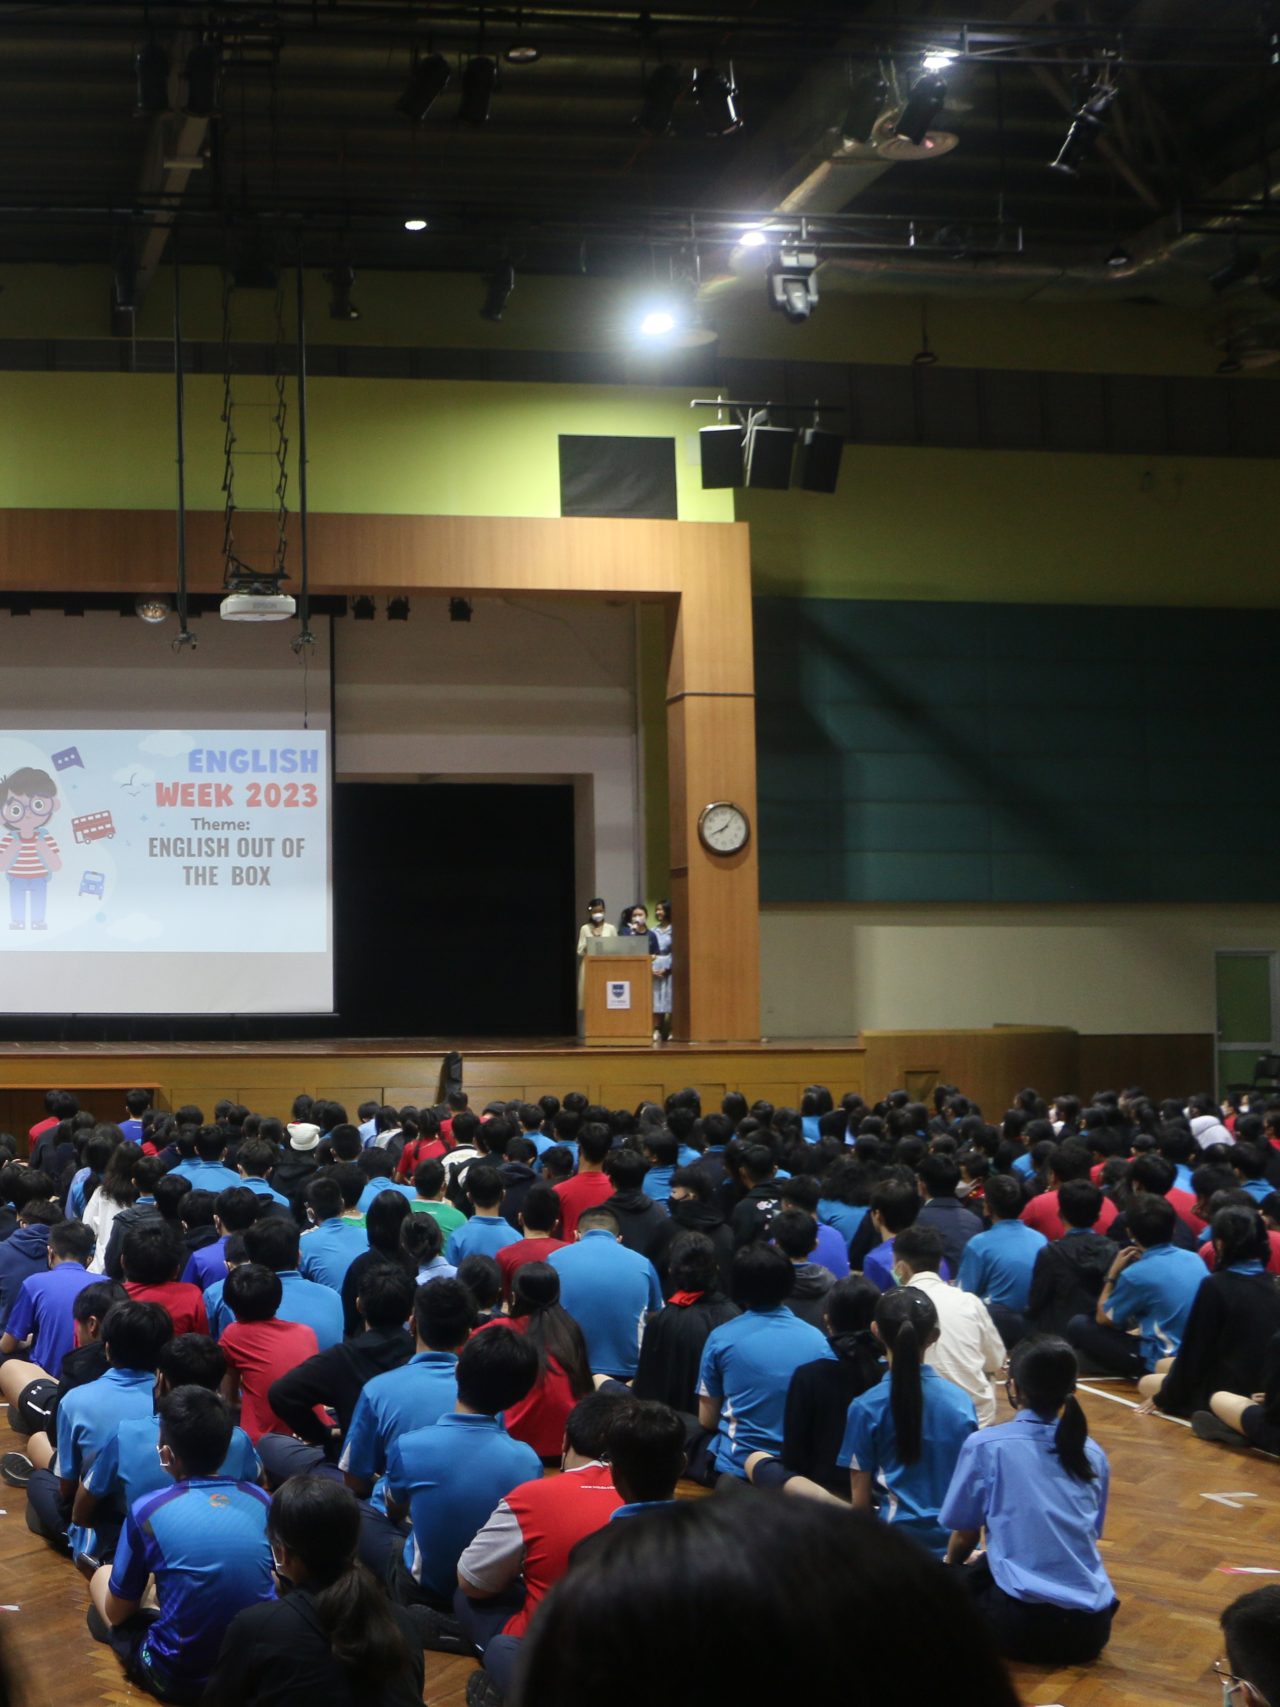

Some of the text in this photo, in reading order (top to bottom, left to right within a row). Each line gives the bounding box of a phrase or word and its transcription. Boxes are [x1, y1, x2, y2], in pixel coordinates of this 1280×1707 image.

[188, 748, 319, 773] ENGLISH
[155, 782, 318, 808] WEEK 2023
[191, 818, 251, 831] Theme:
[148, 837, 306, 859] ENGLISH OUT OF
[183, 865, 271, 887] THE BOX
